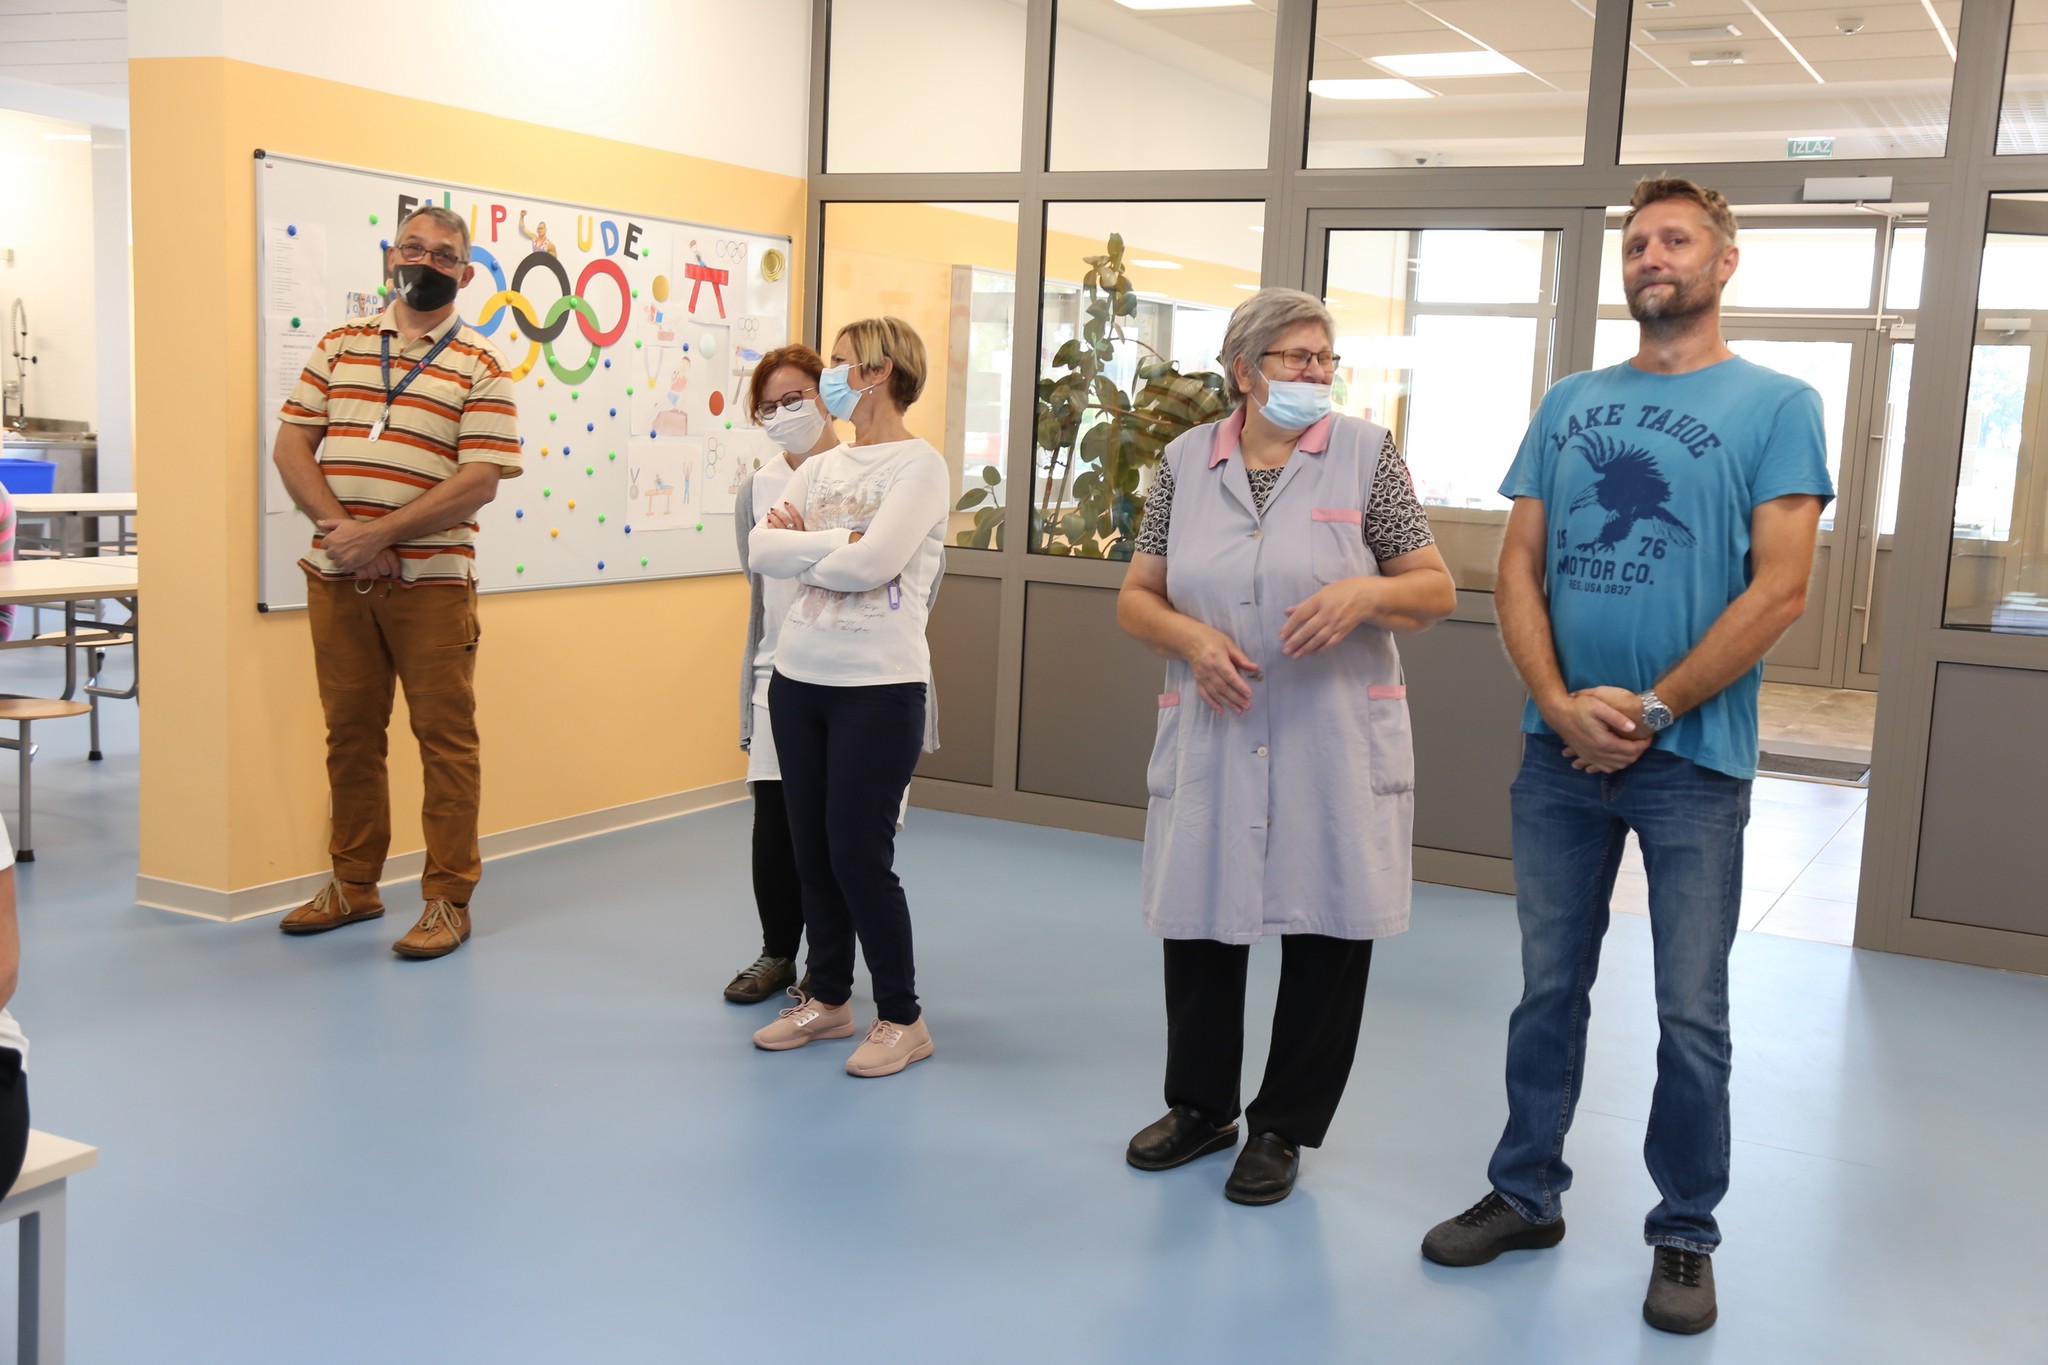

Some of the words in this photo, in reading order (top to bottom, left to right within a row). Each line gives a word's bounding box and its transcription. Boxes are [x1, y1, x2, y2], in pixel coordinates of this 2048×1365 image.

[1792, 140, 1832, 154] IZLAZ
[397, 191, 507, 242] FIP
[577, 214, 643, 260] UDE
[1551, 403, 1626, 452] LAKE
[1636, 404, 1722, 459] TAHOE
[1638, 536, 1667, 560] 76
[1557, 555, 1616, 581] MOTOR
[1621, 561, 1654, 585] CO.
[1584, 582, 1602, 594] USA
[1604, 584, 1632, 596] 0837
